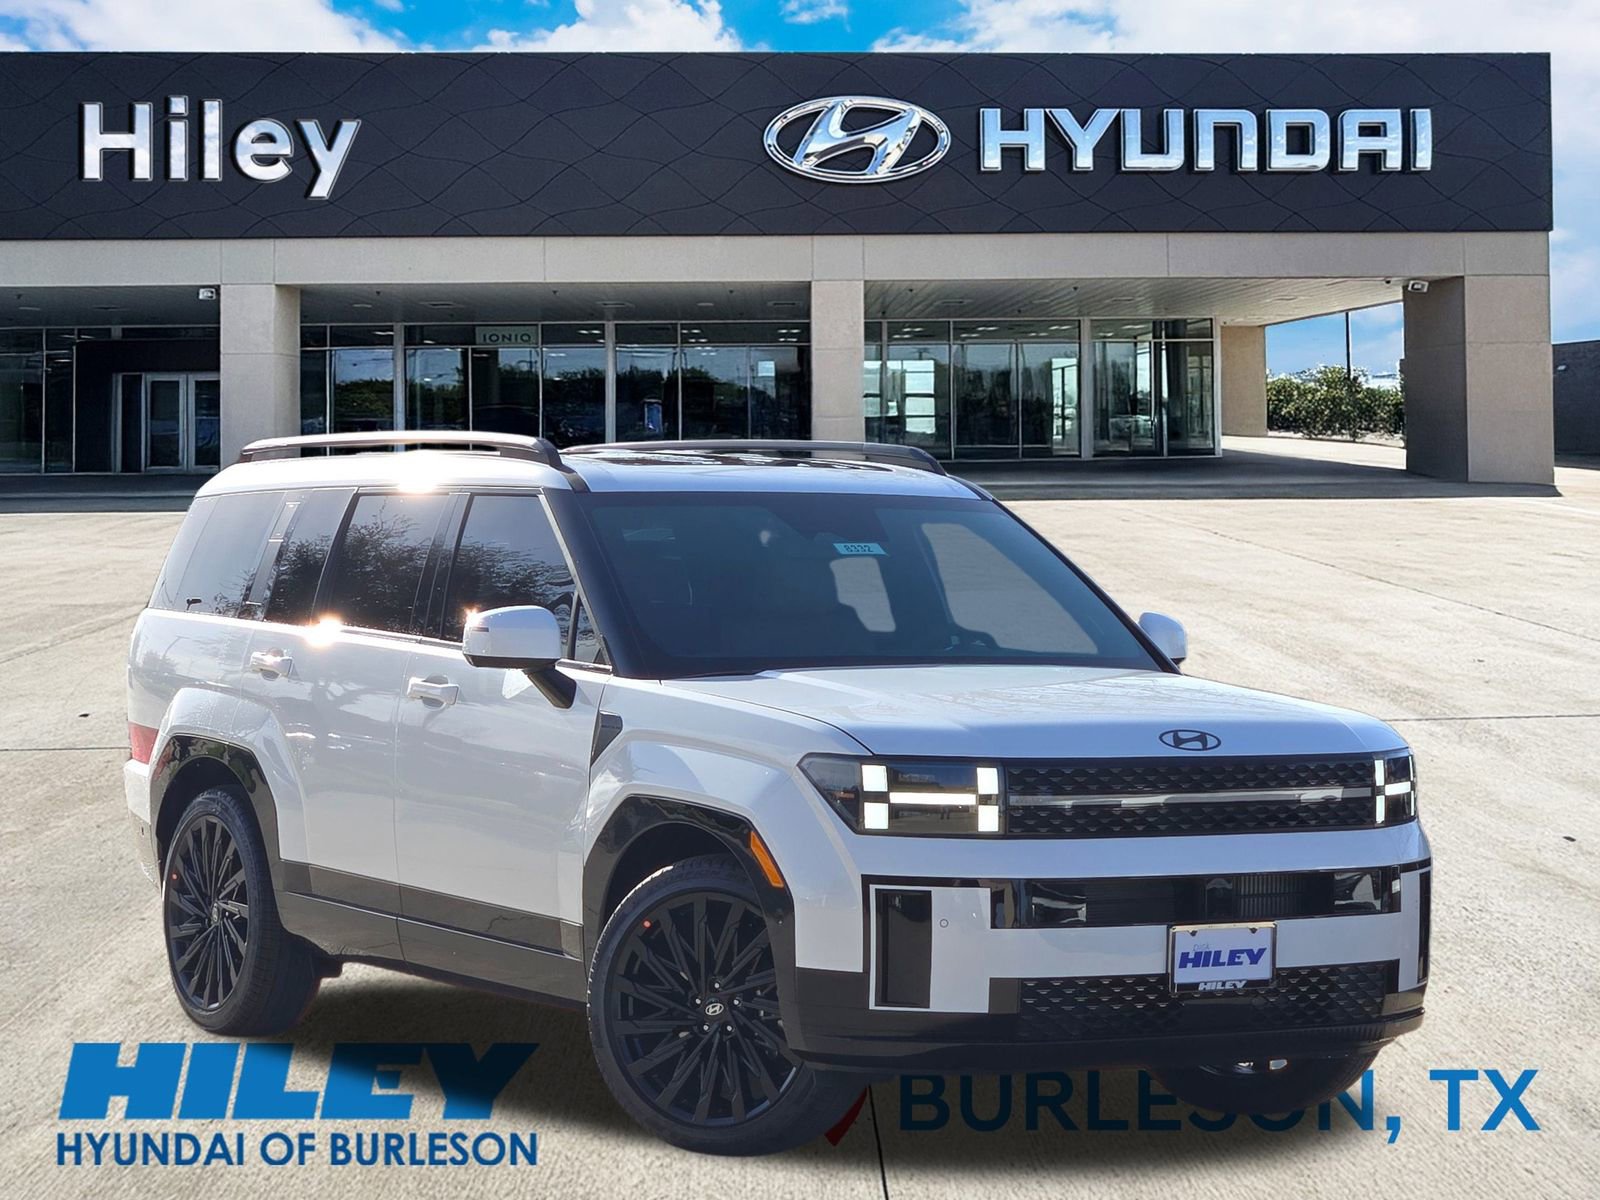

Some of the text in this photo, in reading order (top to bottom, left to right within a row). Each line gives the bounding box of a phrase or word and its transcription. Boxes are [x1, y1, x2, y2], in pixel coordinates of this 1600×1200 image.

[81, 95, 361, 199] Hiley
[979, 108, 1433, 172] HYUNDAI
[843, 544, 874, 553] 8332
[1179, 948, 1267, 968] HILEY
[1198, 980, 1248, 991] HILEY
